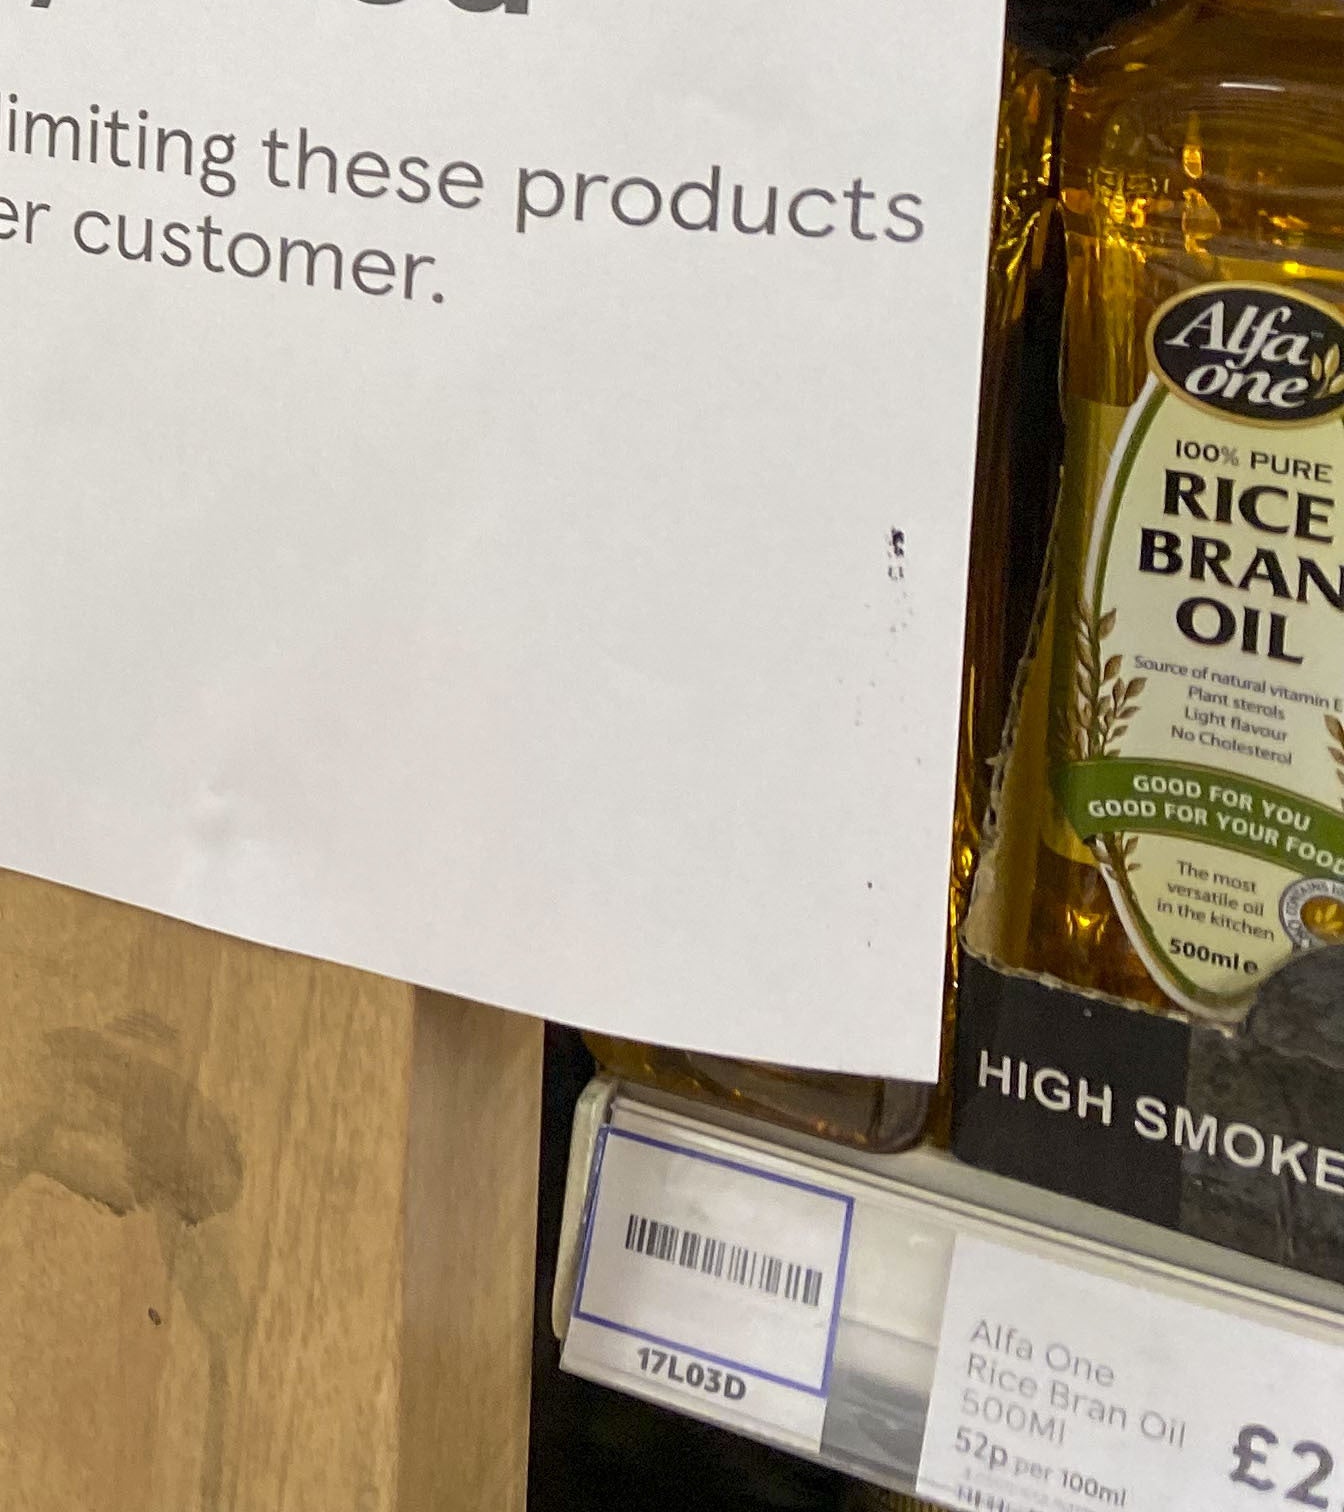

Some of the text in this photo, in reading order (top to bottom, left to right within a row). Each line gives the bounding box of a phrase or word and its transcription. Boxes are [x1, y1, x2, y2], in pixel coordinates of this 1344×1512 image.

[261, 127, 485, 209] these
[515, 164, 926, 243] products
[73, 207, 446, 304] customer.
[1166, 300, 1310, 366] Alfa
[1184, 362, 1310, 408] one
[1176, 439, 1333, 484] 100% PURE
[1163, 468, 1336, 544] RICE
[1139, 527, 1344, 613] BRAN
[1175, 596, 1305, 666] OIL
[1134, 655, 1188, 677] Source
[1191, 666, 1209, 680] of
[1211, 671, 1267, 694] natural
[1269, 685, 1330, 710] vitamin
[1188, 685, 1285, 721] Plant sterols
[1171, 724, 1293, 766] No Cholesterol
[1184, 705, 1289, 743] Light flavour
[1088, 798, 1157, 818] GOOD
[1163, 801, 1209, 827] FOR
[1216, 810, 1280, 848] YOUR
[1133, 774, 1312, 833] GOOD FOR YOU
[1166, 881, 1265, 917] versatile oil
[1176, 859, 1257, 894] The most
[1156, 897, 1173, 914] in
[1177, 902, 1207, 923] the
[1209, 912, 1276, 943] kitchen
[1169, 937, 1240, 972] 500ml
[977, 1049, 1344, 1195] HIGH SMOKE
[637, 1346, 748, 1403] 17L03D
[969, 1319, 1115, 1387] Alfa One
[967, 1351, 1186, 1448] Rice Bran Oil
[955, 1427, 1009, 1471] 52p
[1013, 1456, 1054, 1485] per
[1061, 1466, 1128, 1509] 100ml
